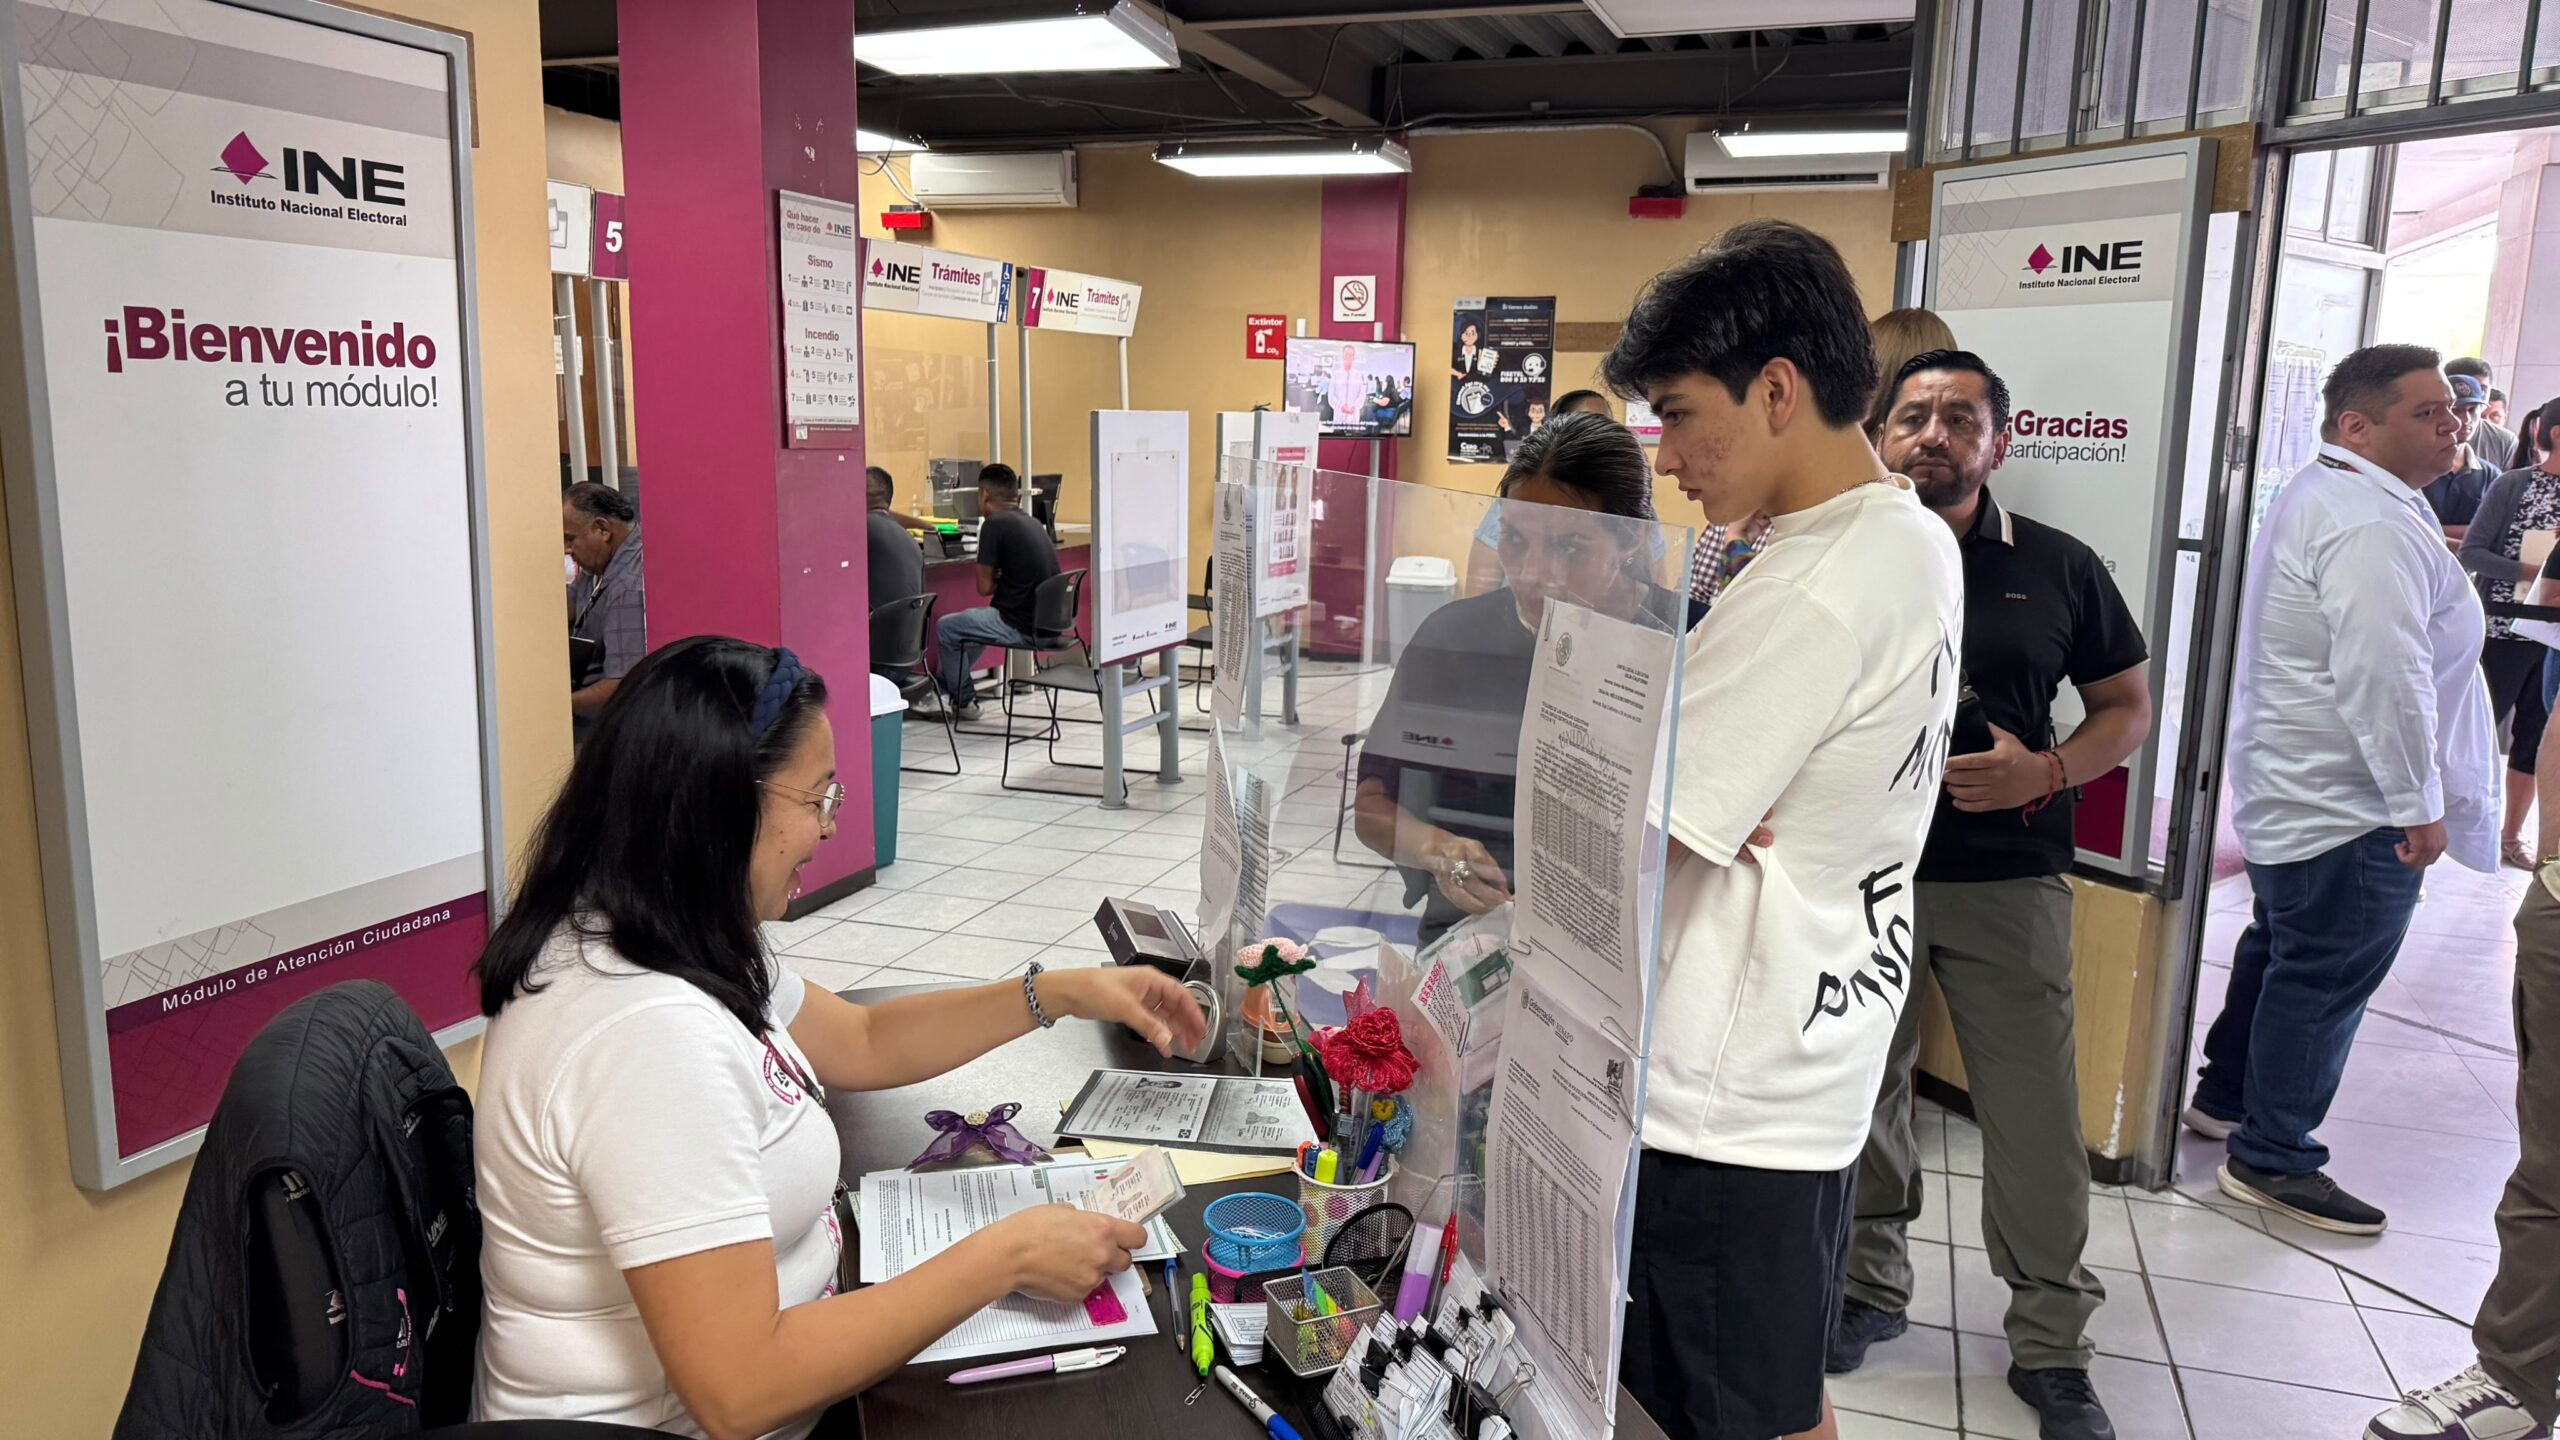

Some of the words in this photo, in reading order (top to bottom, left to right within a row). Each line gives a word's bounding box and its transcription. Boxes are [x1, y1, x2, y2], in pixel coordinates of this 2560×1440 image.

[283, 147, 406, 206] INE
[210, 190, 276, 212] Instituto
[280, 198, 343, 219] Nacional
[347, 205, 407, 227] Electoral
[605, 221, 623, 253] 5
[834, 224, 852, 235] INE
[808, 254, 833, 269] Sismo
[2061, 240, 2143, 274] INE
[887, 262, 921, 284] INE
[932, 262, 981, 286] Trámites
[2019, 279, 2055, 290] Instituto
[2057, 276, 2096, 288] Nacional
[2098, 274, 2140, 285] Electoral
[1032, 287, 1041, 309] 7
[1056, 291, 1079, 308] INE
[1088, 288, 1120, 306] Trámites
[1249, 317, 1284, 327] Extintor
[104, 305, 437, 374] ¡Bienvenido
[805, 327, 839, 342] Incendio
[225, 380, 249, 407] a
[261, 373, 293, 406] tu
[306, 373, 438, 408] módulo!
[162, 976, 237, 1013] Módulo
[245, 966, 268, 982] de
[276, 937, 355, 974] Atención
[363, 907, 451, 945] Ciudadana
